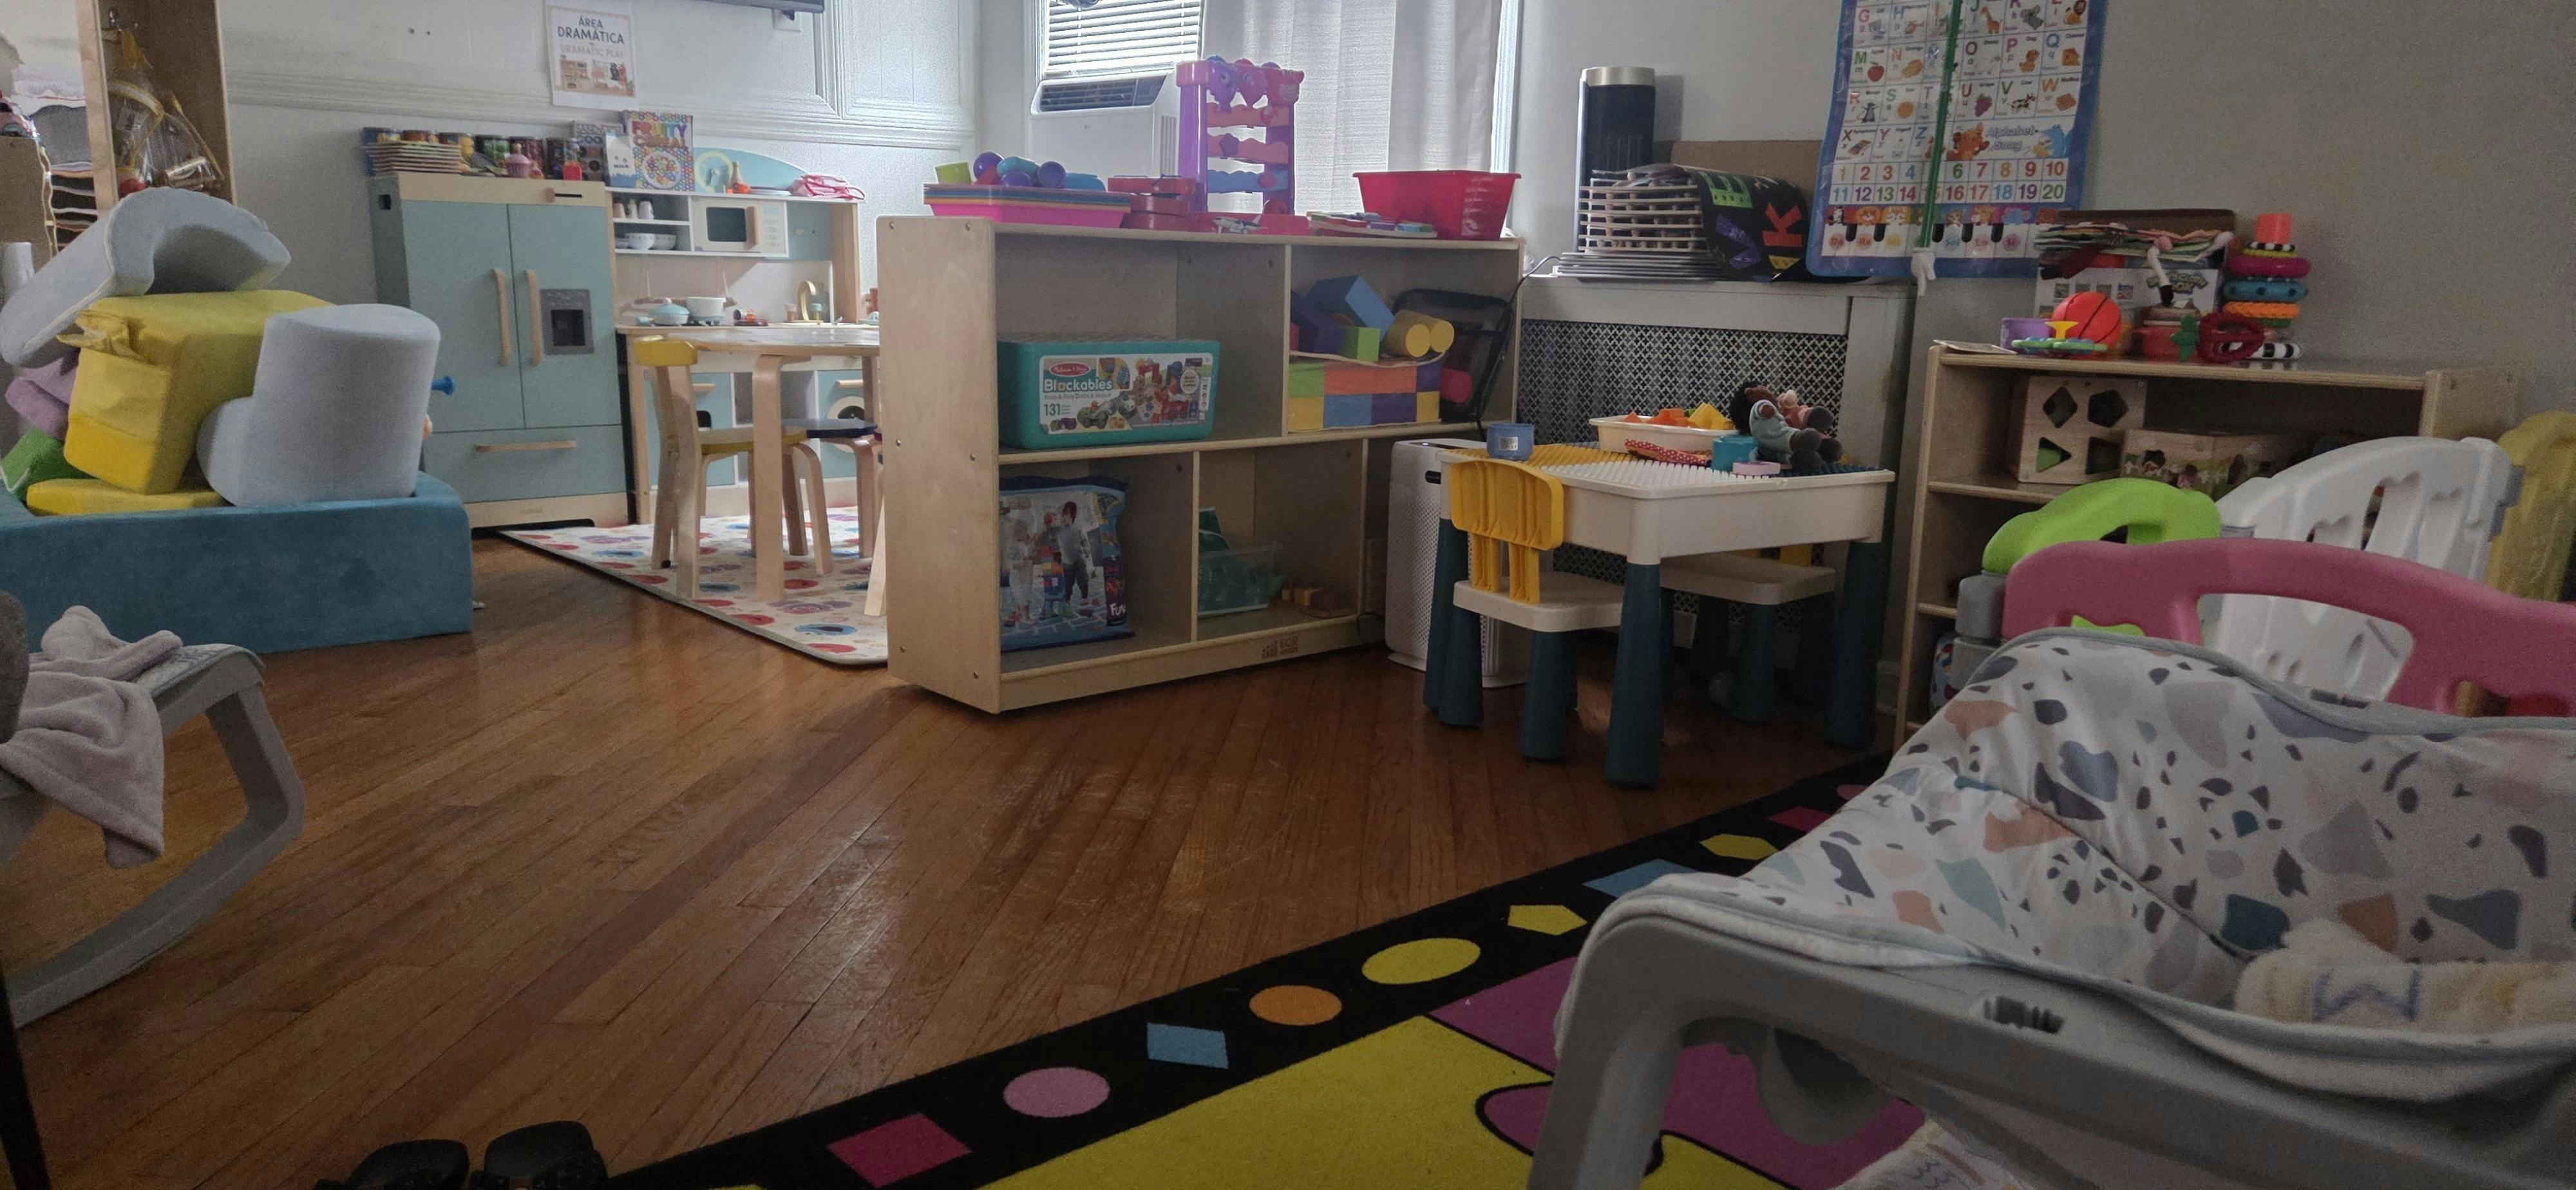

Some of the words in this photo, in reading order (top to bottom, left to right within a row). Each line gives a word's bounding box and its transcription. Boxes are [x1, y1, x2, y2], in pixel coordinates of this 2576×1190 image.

[1859, 9, 1870, 22] G
[1893, 6, 1905, 19] H
[578, 15, 603, 28] ÁREA
[557, 26, 625, 44] DRAMÁTICA
[2046, 33, 2060, 48] Q
[560, 43, 603, 56] DRAMATIC
[606, 48, 625, 58] PLAY
[1965, 41, 1978, 55] O
[2007, 38, 2018, 52] P
[1854, 51, 1867, 65] M
[1891, 48, 1902, 62] N
[1962, 82, 1972, 97] U
[2002, 81, 2013, 95] V
[2042, 78, 2059, 92] W
[1850, 91, 1861, 104] R
[1886, 88, 1897, 102] S
[1923, 86, 1933, 100] T
[631, 120, 687, 137] FRUITY
[1841, 129, 1853, 141] X
[1880, 128, 1891, 140] Y
[1915, 127, 1927, 140] Z
[1840, 166, 1846, 181] 1
[1860, 165, 1871, 180] 2
[1883, 165, 1893, 181] 3
[1906, 164, 1915, 180] 4
[1953, 163, 1963, 179] 6
[1976, 163, 1987, 178] 7
[2000, 162, 2011, 178] 8
[2025, 161, 2036, 177] 9
[2047, 161, 2064, 176] 10
[1833, 187, 1848, 202] 11
[1855, 187, 1872, 202] 12
[1877, 186, 1894, 202] 13
[1899, 185, 1917, 202] 14
[1946, 185, 1964, 200] 16
[1970, 185, 1989, 200] 17
[1994, 184, 2013, 200] 18
[2018, 184, 2037, 200] 19
[2043, 184, 2063, 200] 20
[1043, 378, 1113, 393] Blockables
[1044, 403, 1061, 416] 131
